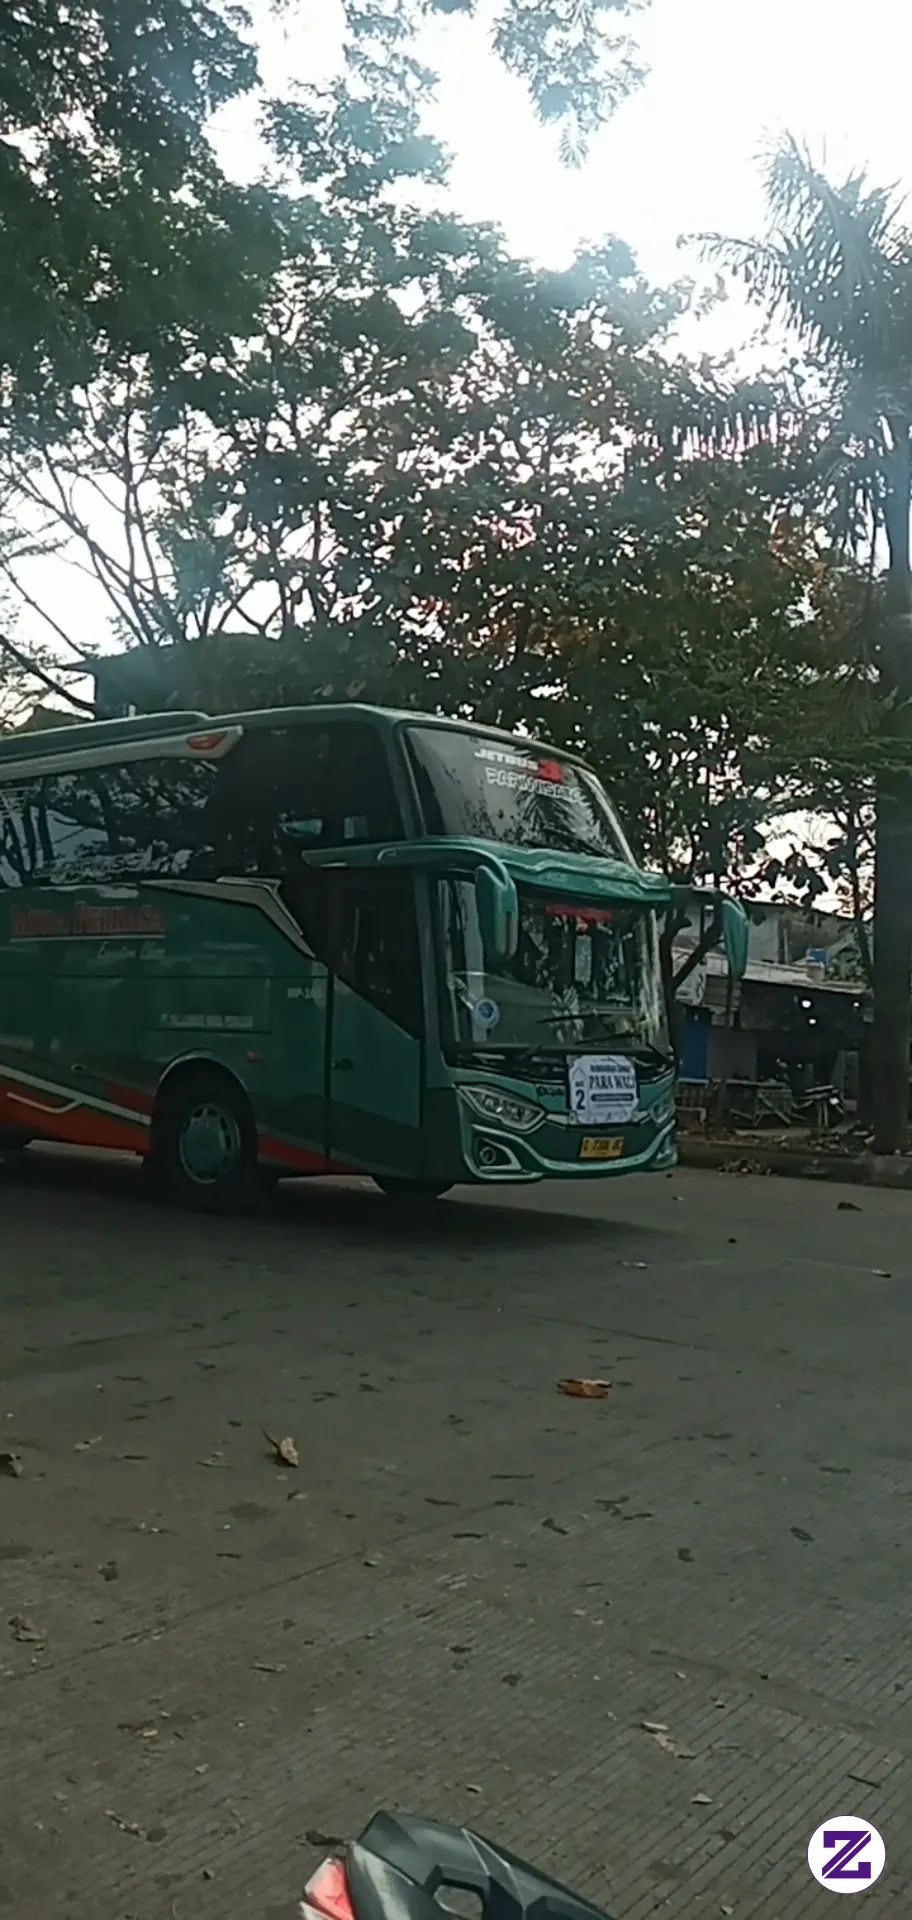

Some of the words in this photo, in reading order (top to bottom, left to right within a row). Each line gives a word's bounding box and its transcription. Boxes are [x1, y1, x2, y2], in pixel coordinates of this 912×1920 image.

[474, 748, 539, 771] JETBUS
[588, 1075, 614, 1090] PARA
[575, 1089, 586, 1110] 2
